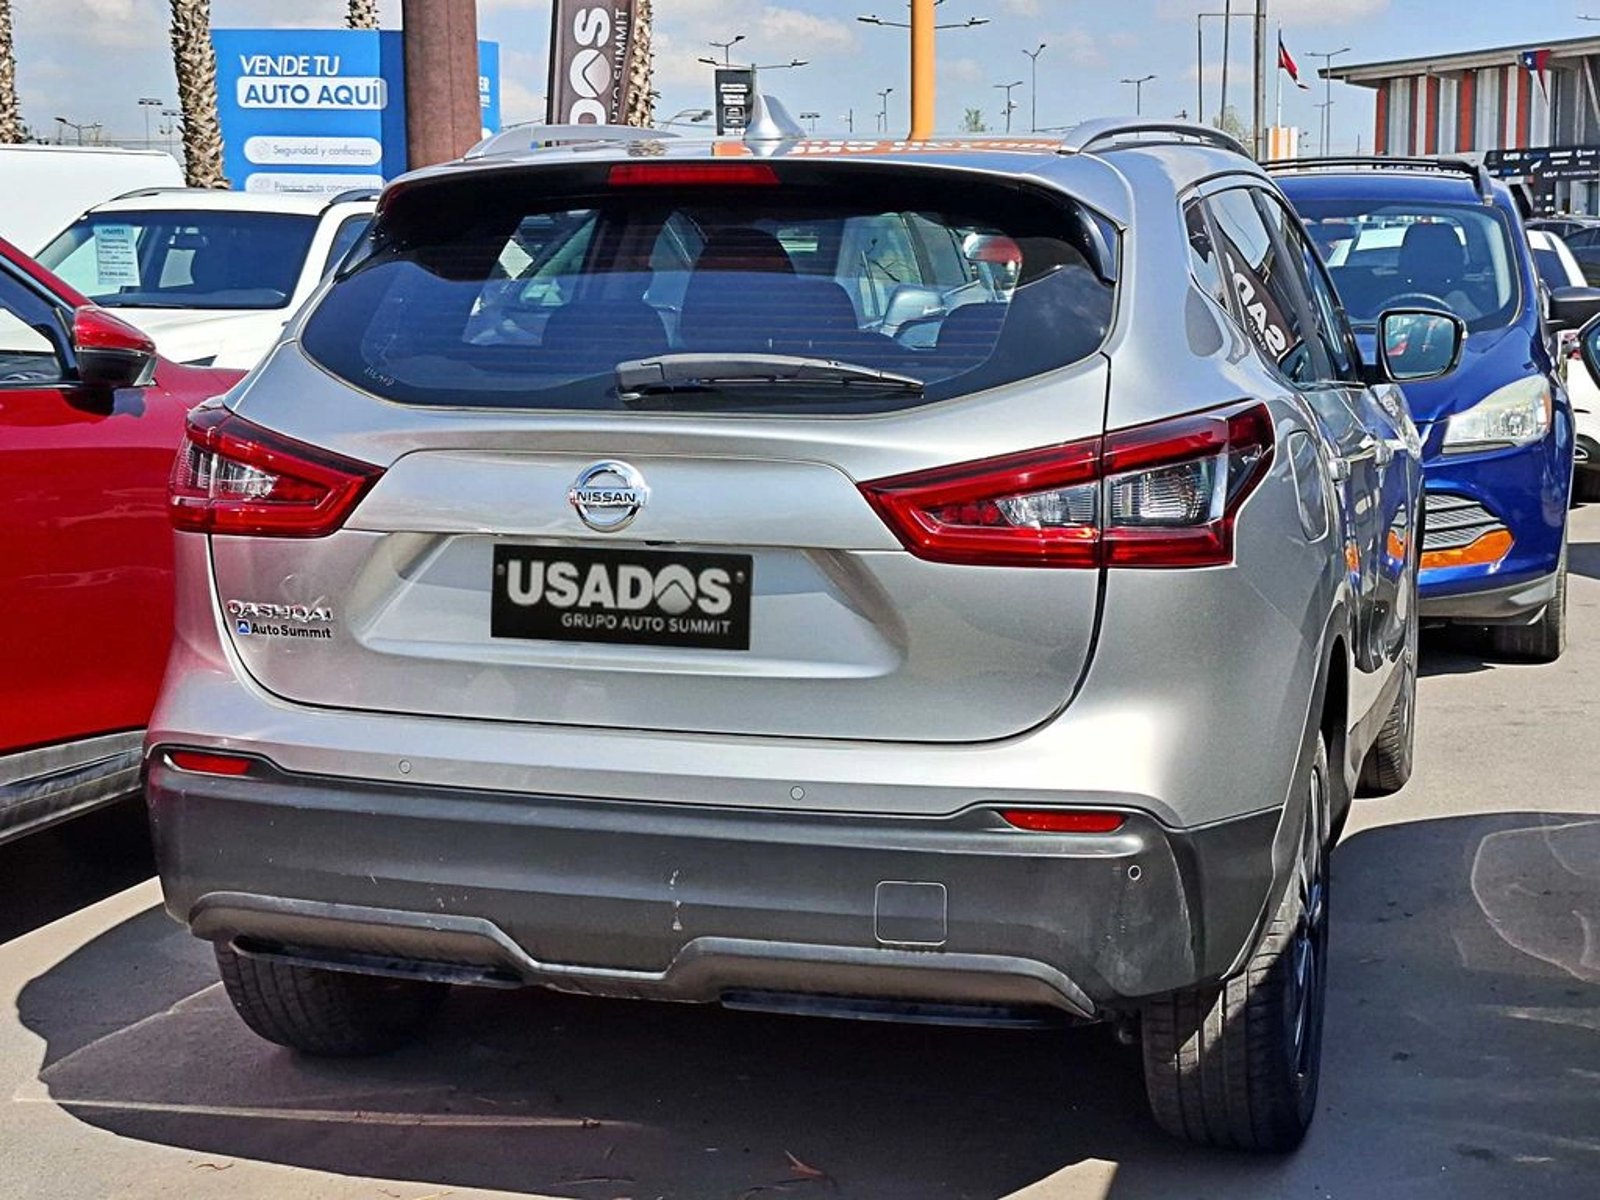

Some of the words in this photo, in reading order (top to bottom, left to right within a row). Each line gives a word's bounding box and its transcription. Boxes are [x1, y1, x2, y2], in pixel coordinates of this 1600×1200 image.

[240, 55, 309, 76] VENDE
[314, 55, 340, 76] TU
[244, 84, 309, 105] AUTO
[317, 79, 379, 105] AQUÍ
[272, 144, 319, 157] Seguridad
[576, 491, 636, 504] NISSAN
[507, 559, 732, 615] USADOS
[561, 613, 617, 629] GRUPO
[621, 616, 664, 631] AUTO
[669, 618, 731, 634] SUMMIT
